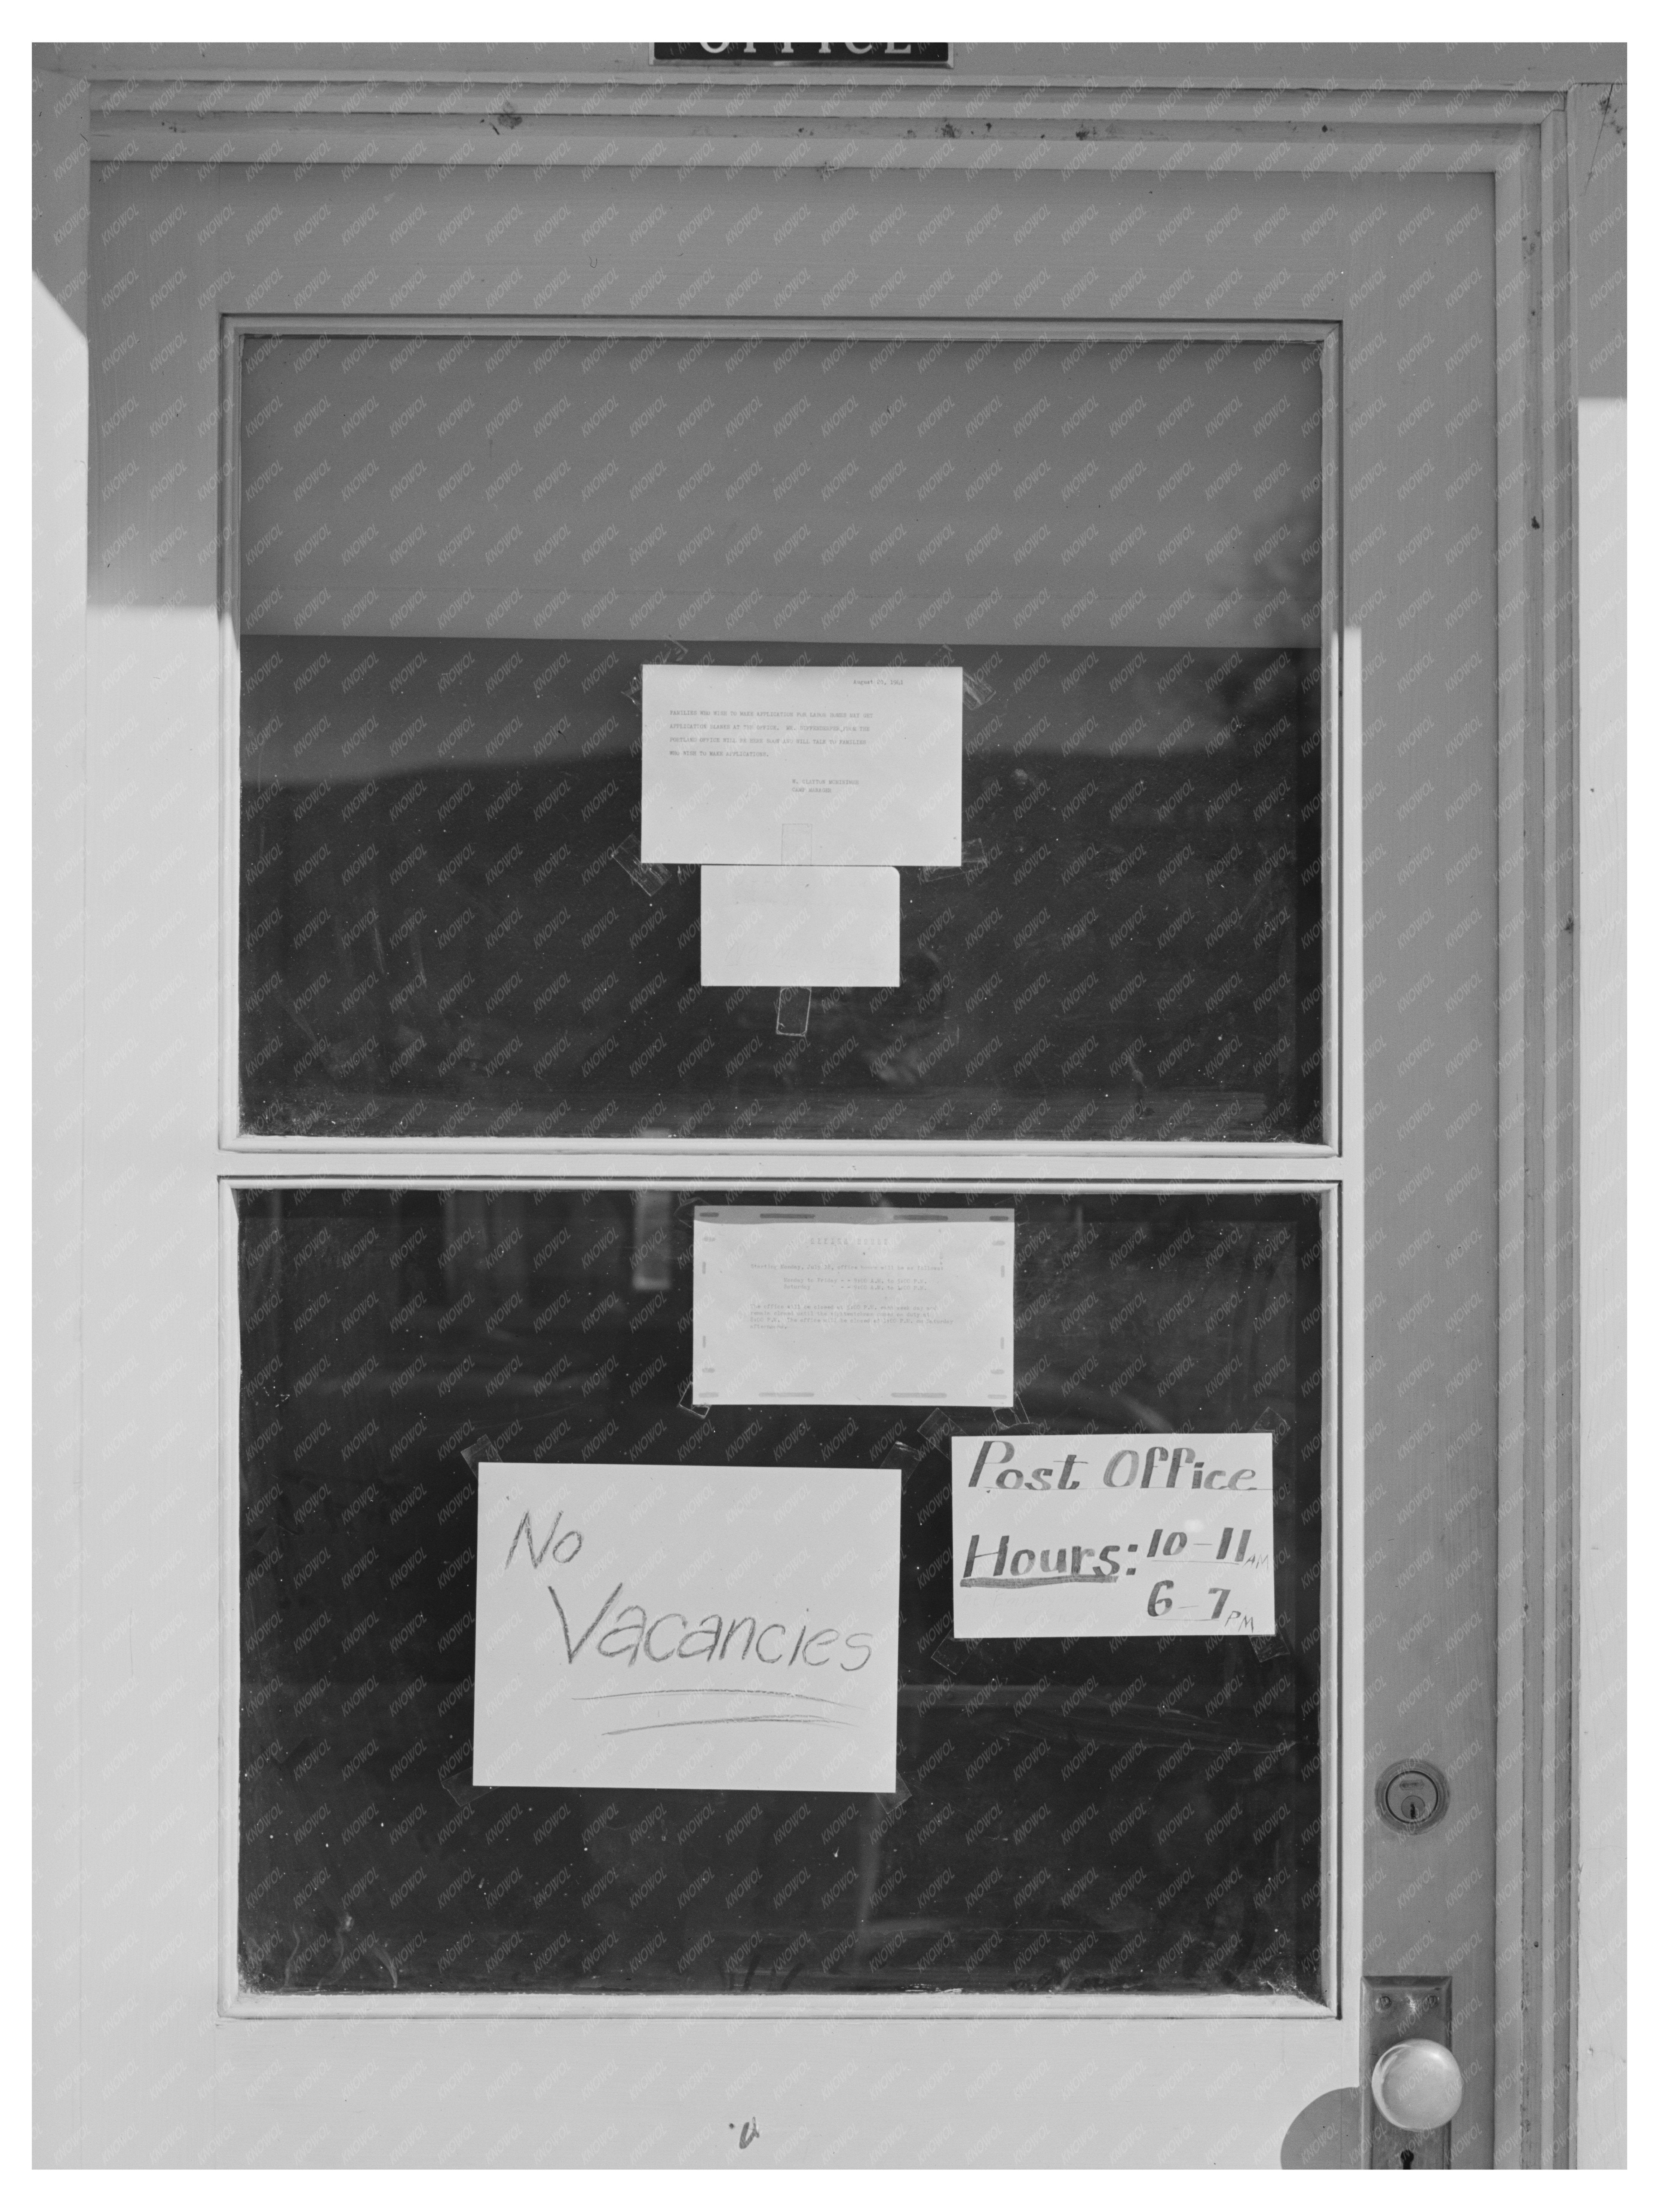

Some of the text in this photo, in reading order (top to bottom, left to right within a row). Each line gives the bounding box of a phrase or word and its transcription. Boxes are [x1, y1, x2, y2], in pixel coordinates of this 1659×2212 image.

[968, 1441, 1257, 1490] Post Office
[505, 1510, 584, 1570] No
[963, 1535, 1138, 1577] Hours:
[1242, 1554, 1269, 1570] AM
[548, 1582, 874, 1672] Vacancies
[1225, 1611, 1254, 1633] PM
